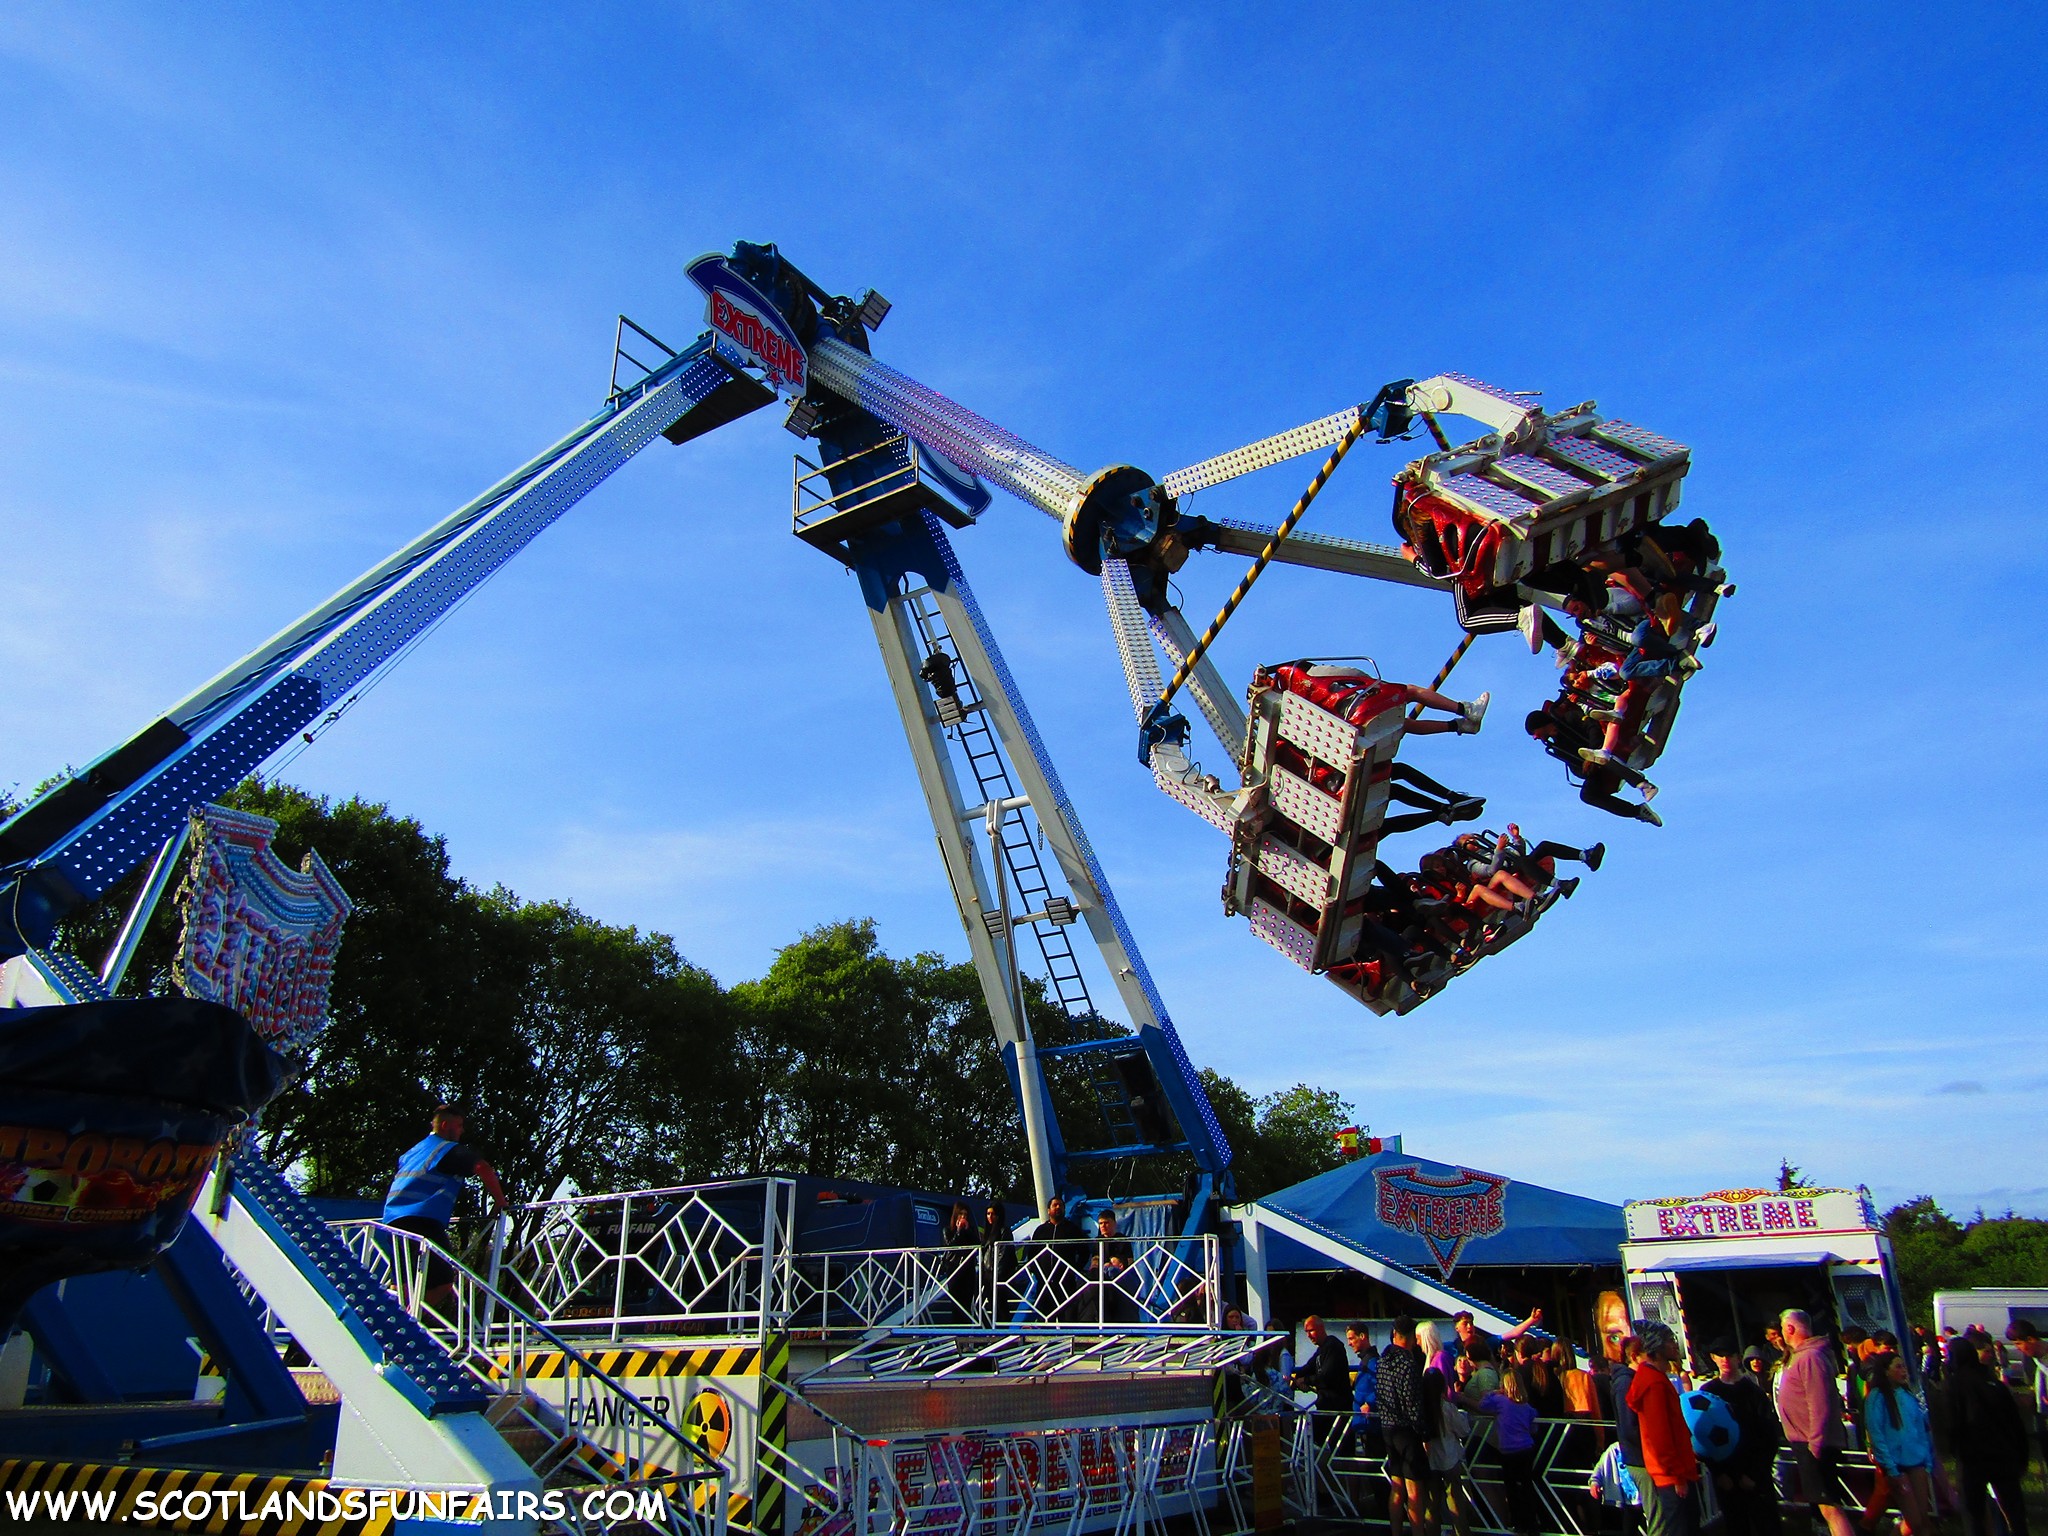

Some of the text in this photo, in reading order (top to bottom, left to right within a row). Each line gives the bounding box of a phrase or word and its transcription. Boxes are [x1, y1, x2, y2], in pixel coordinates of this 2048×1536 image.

[711, 290, 805, 387] EXTREME
[1380, 1182, 1501, 1236] EXTREME
[1657, 1200, 1817, 1236] EXTREME
[607, 1223, 656, 1235] FUFAIR
[569, 1396, 670, 1427] DANGER
